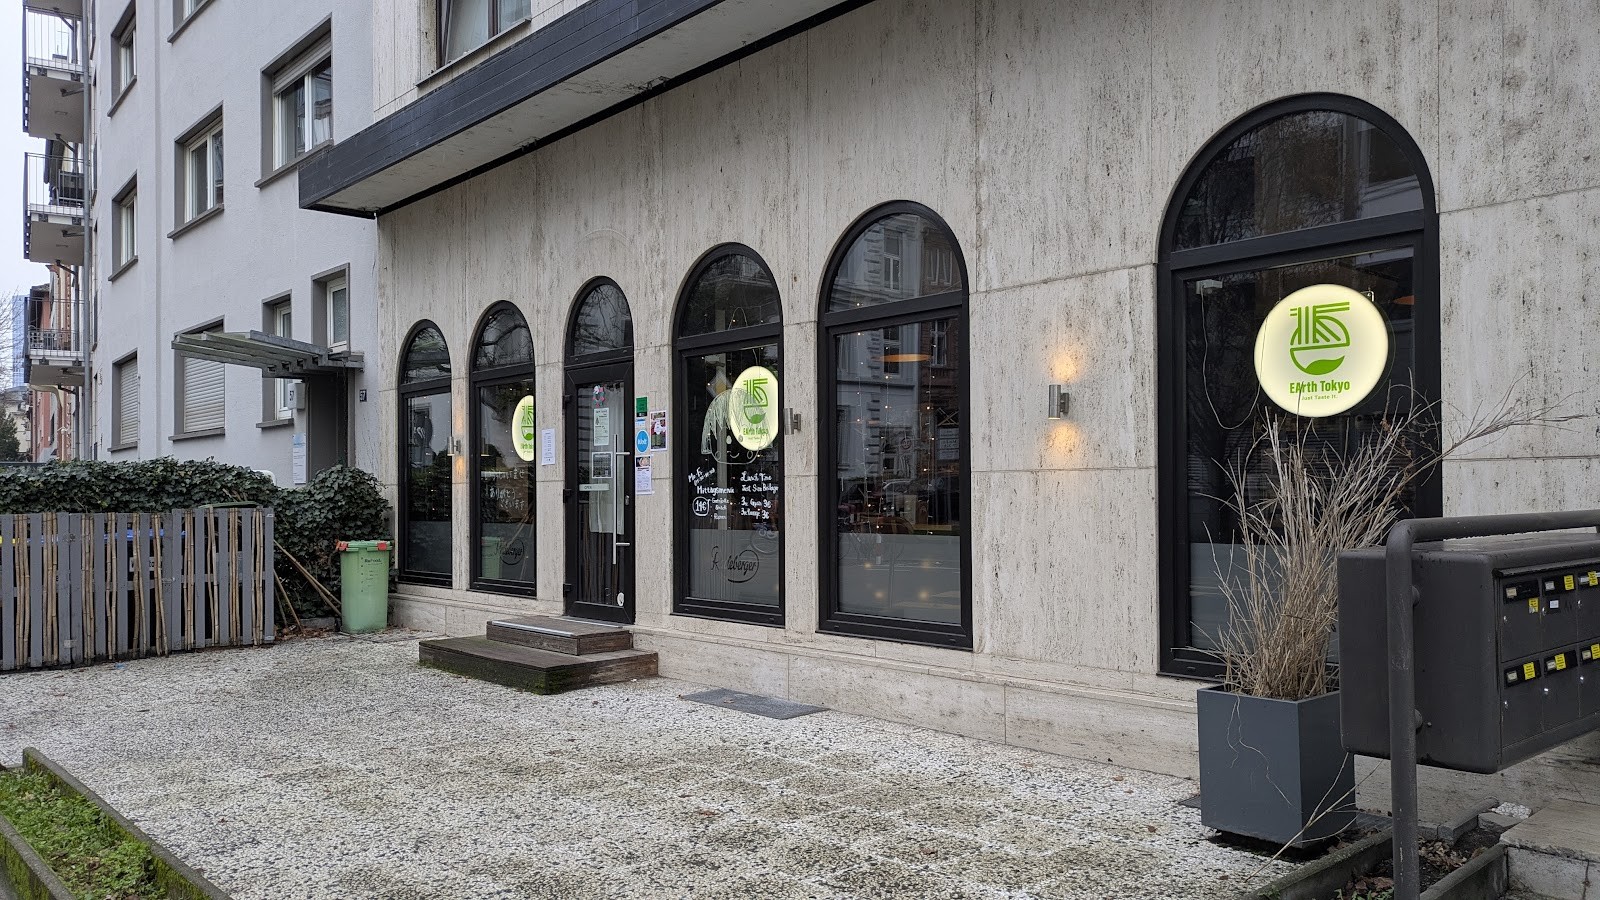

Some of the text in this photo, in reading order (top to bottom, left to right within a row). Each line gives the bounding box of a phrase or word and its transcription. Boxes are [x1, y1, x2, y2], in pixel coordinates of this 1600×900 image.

[1290, 380, 1350, 394] EArth Tokyo
[360, 391, 366, 400] 57
